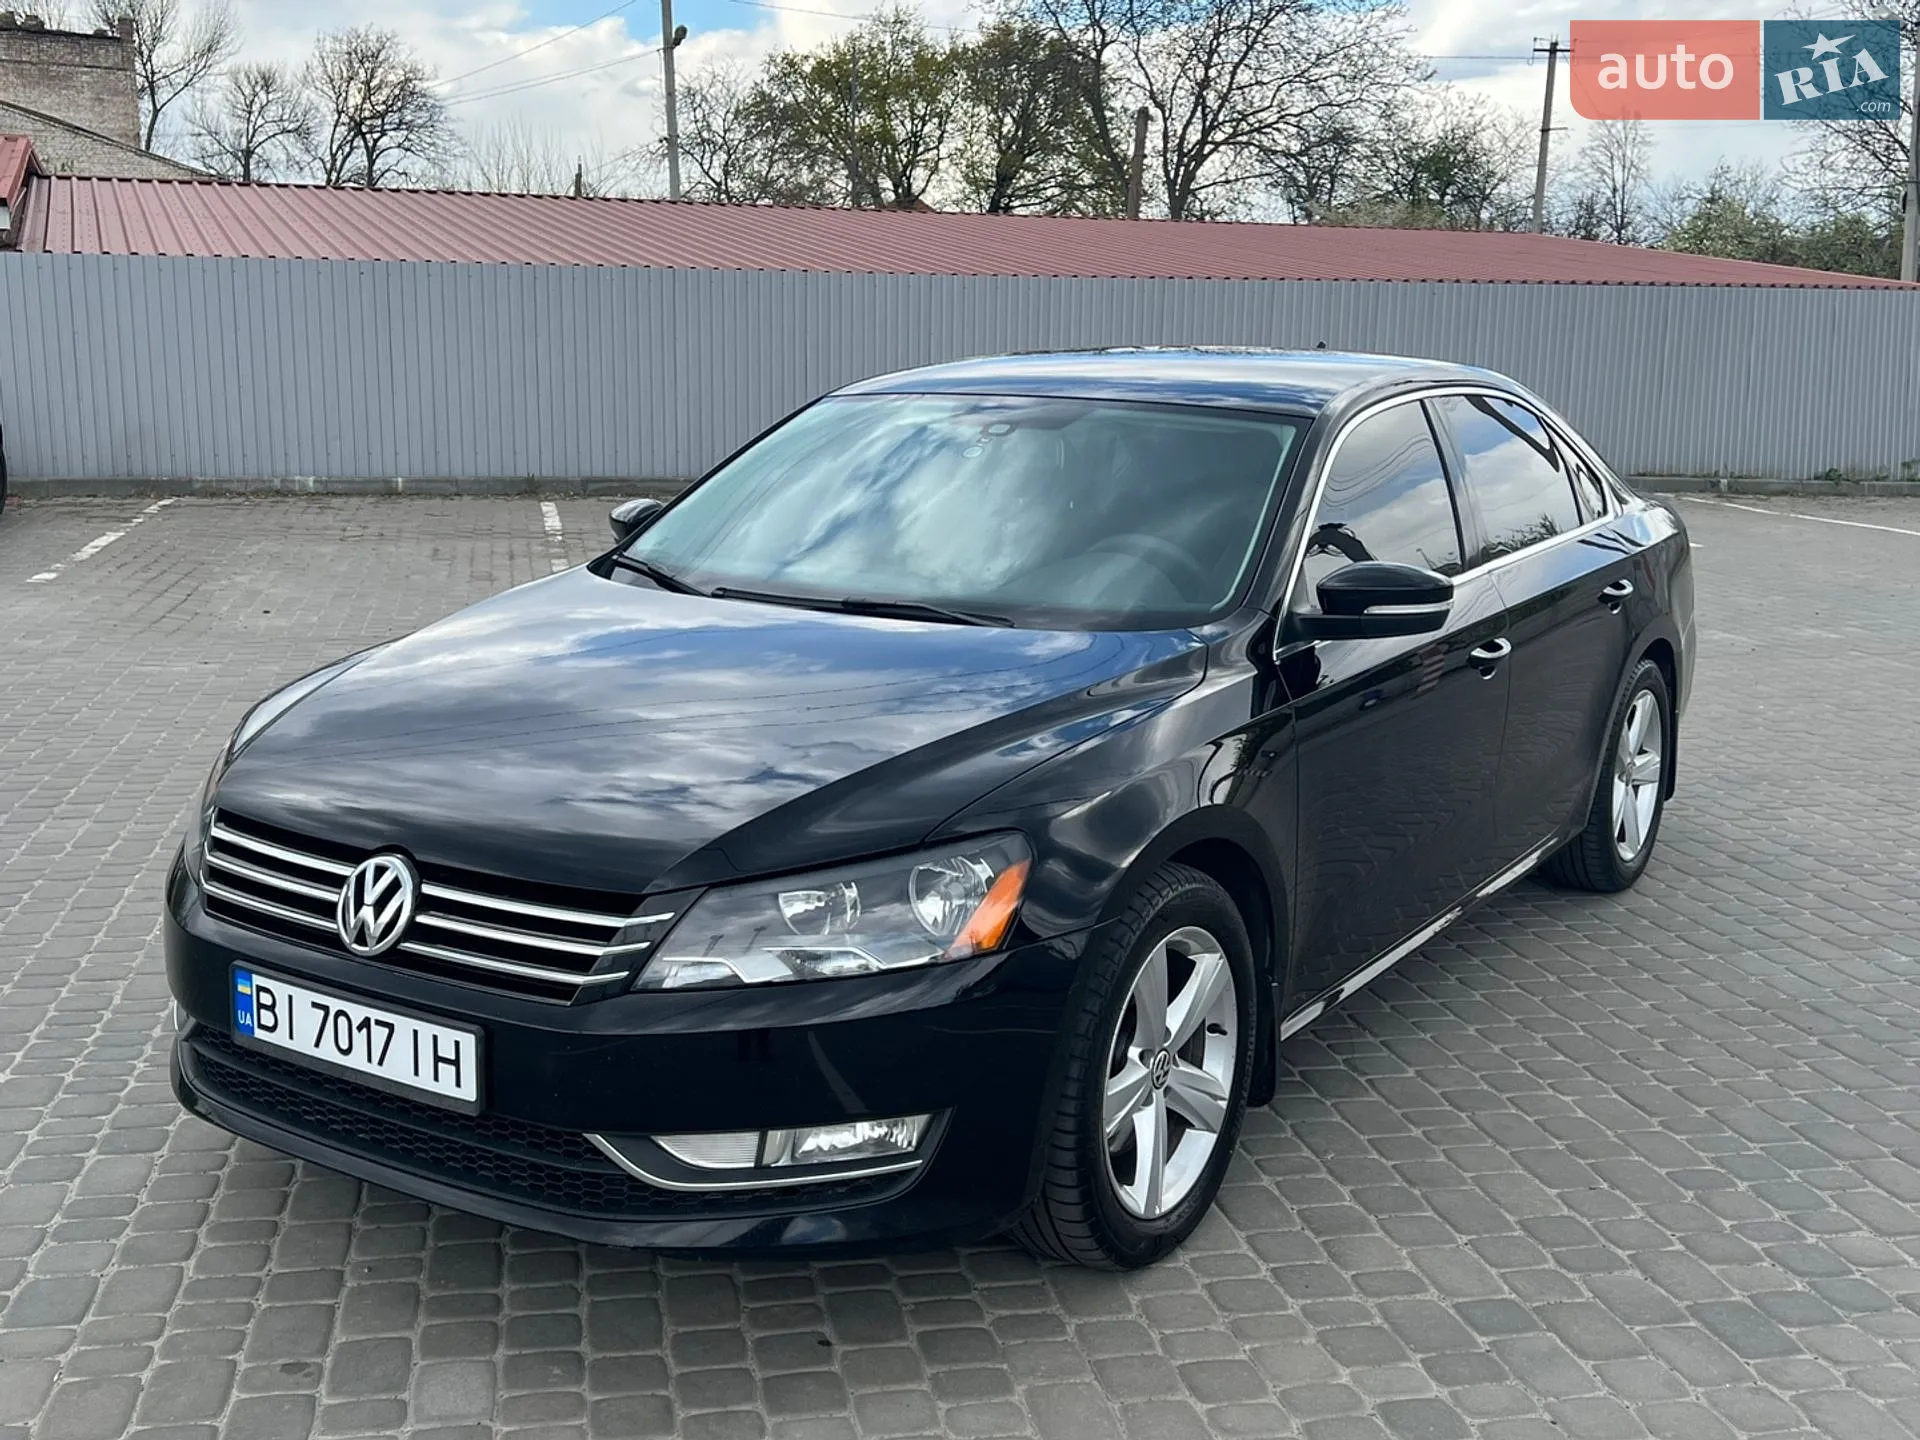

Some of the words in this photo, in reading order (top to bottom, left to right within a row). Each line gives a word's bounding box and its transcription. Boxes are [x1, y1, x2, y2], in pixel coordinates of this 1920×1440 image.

[238, 1012, 252, 1026] UA
[255, 984, 294, 1040] BI
[311, 1001, 394, 1067] 7017
[413, 1029, 461, 1088] IH
